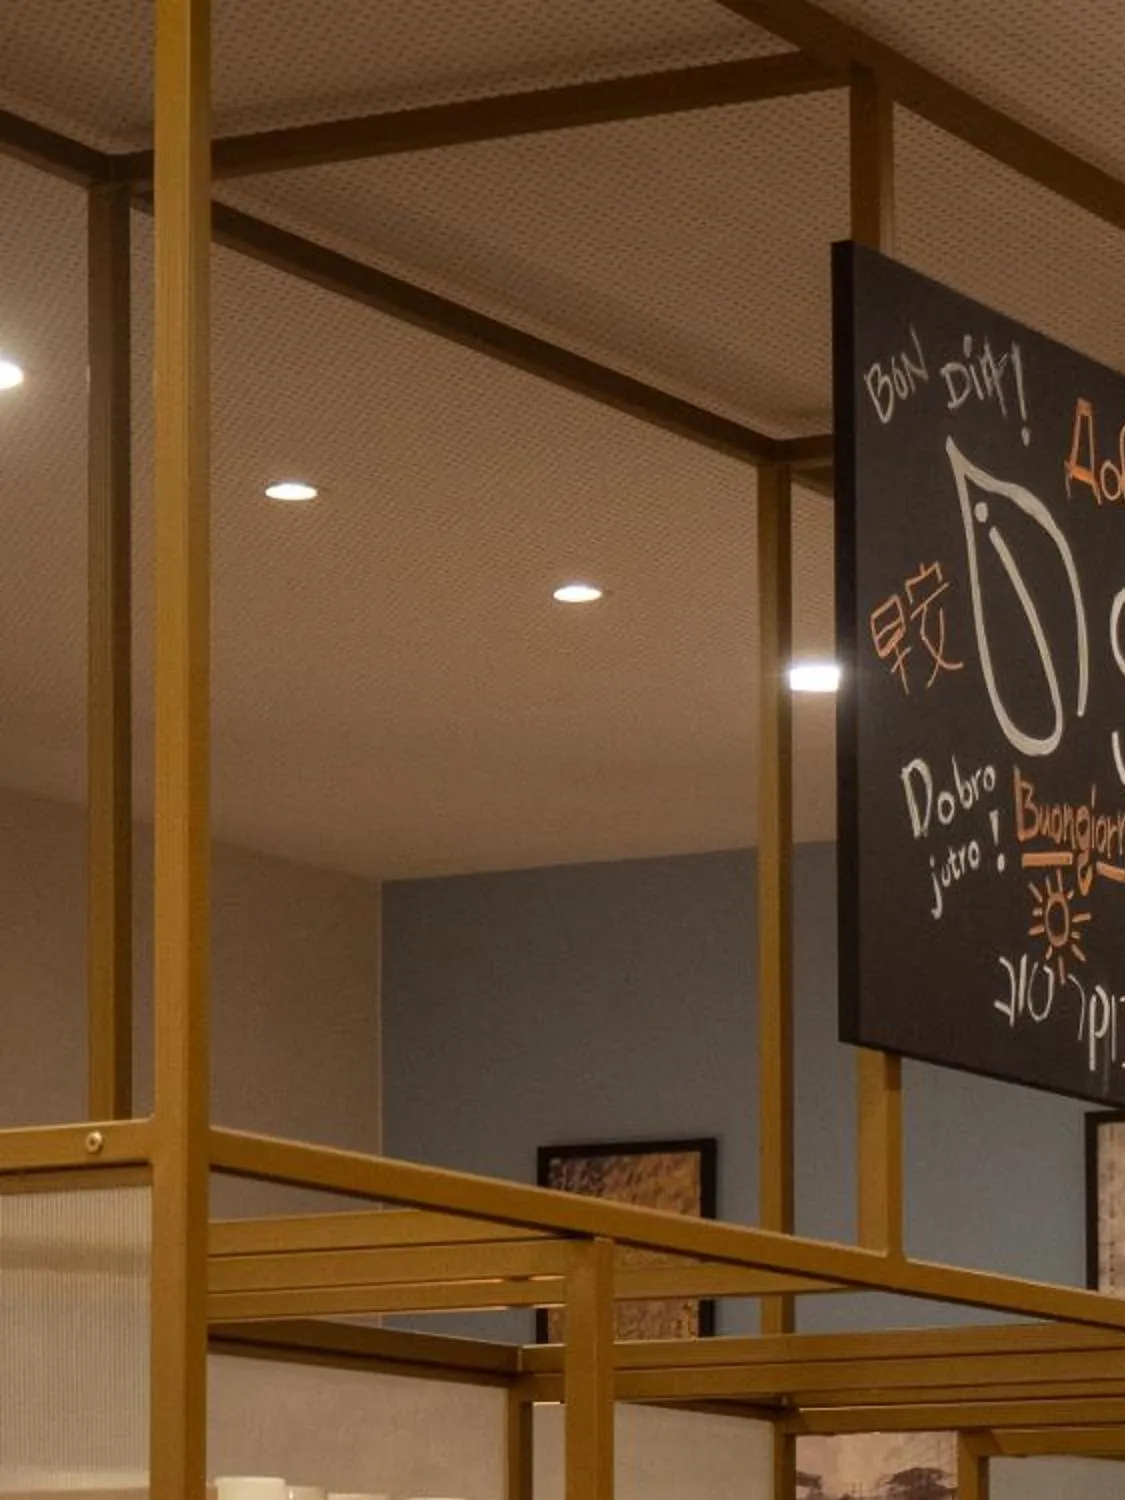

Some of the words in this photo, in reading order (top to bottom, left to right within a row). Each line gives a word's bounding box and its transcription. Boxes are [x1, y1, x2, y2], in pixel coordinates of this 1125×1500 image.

[864, 324, 928, 424] BON
[869, 561, 964, 694] 早安
[900, 756, 997, 839] Dobro
[993, 954, 1055, 1028] טוב
